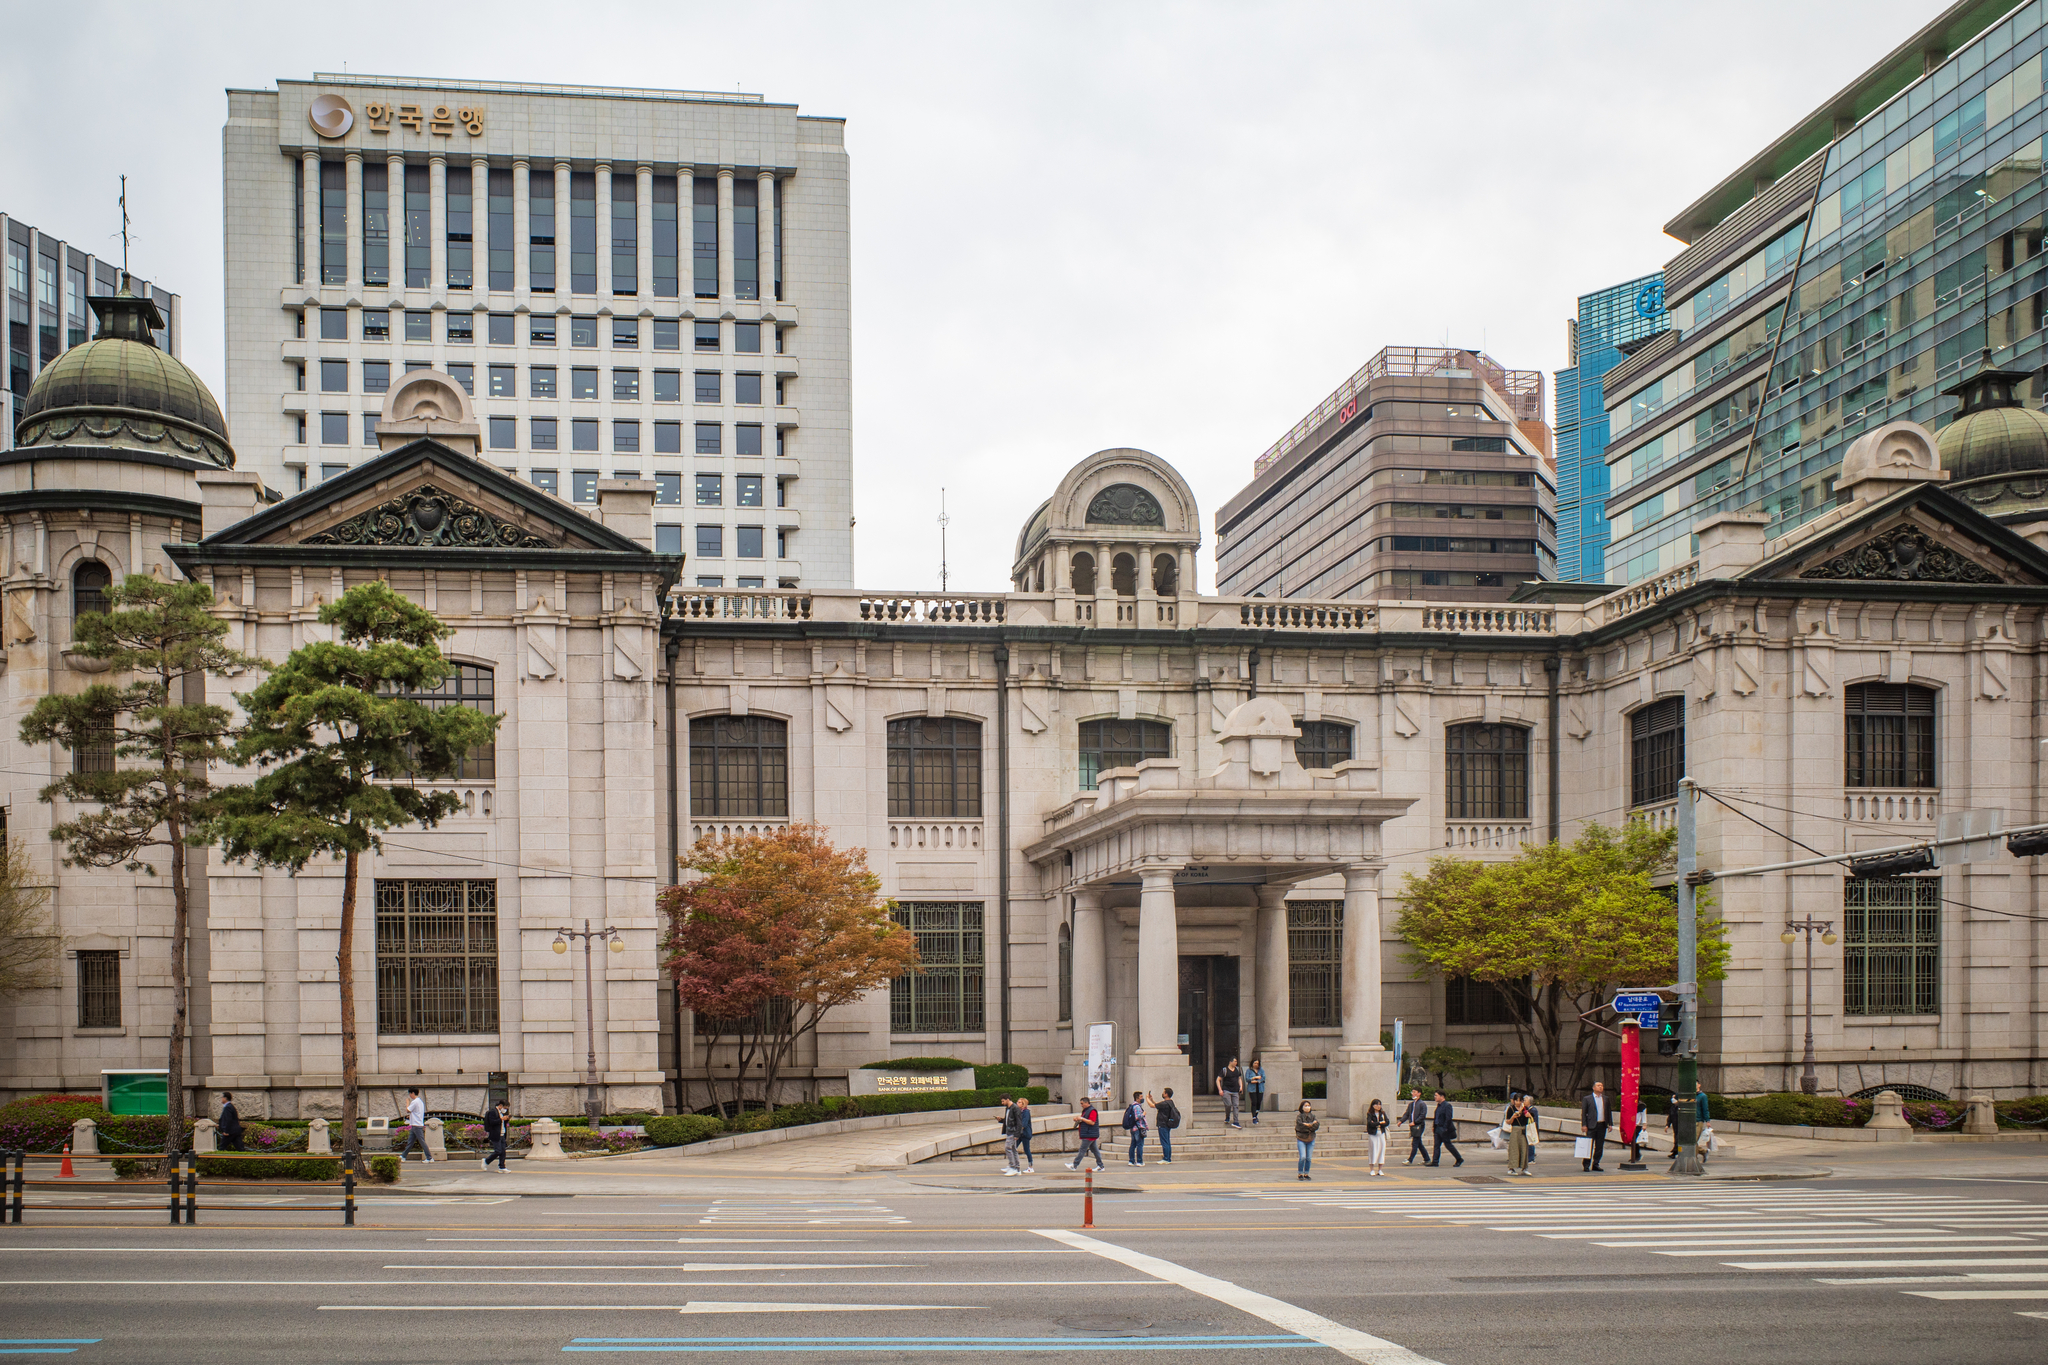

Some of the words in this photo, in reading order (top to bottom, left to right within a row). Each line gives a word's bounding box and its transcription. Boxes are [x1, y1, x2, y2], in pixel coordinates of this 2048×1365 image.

[365, 101, 485, 137] 한국은행
[877, 1076, 907, 1086] 한국은행
[910, 1076, 948, 1085] 화폐박물관
